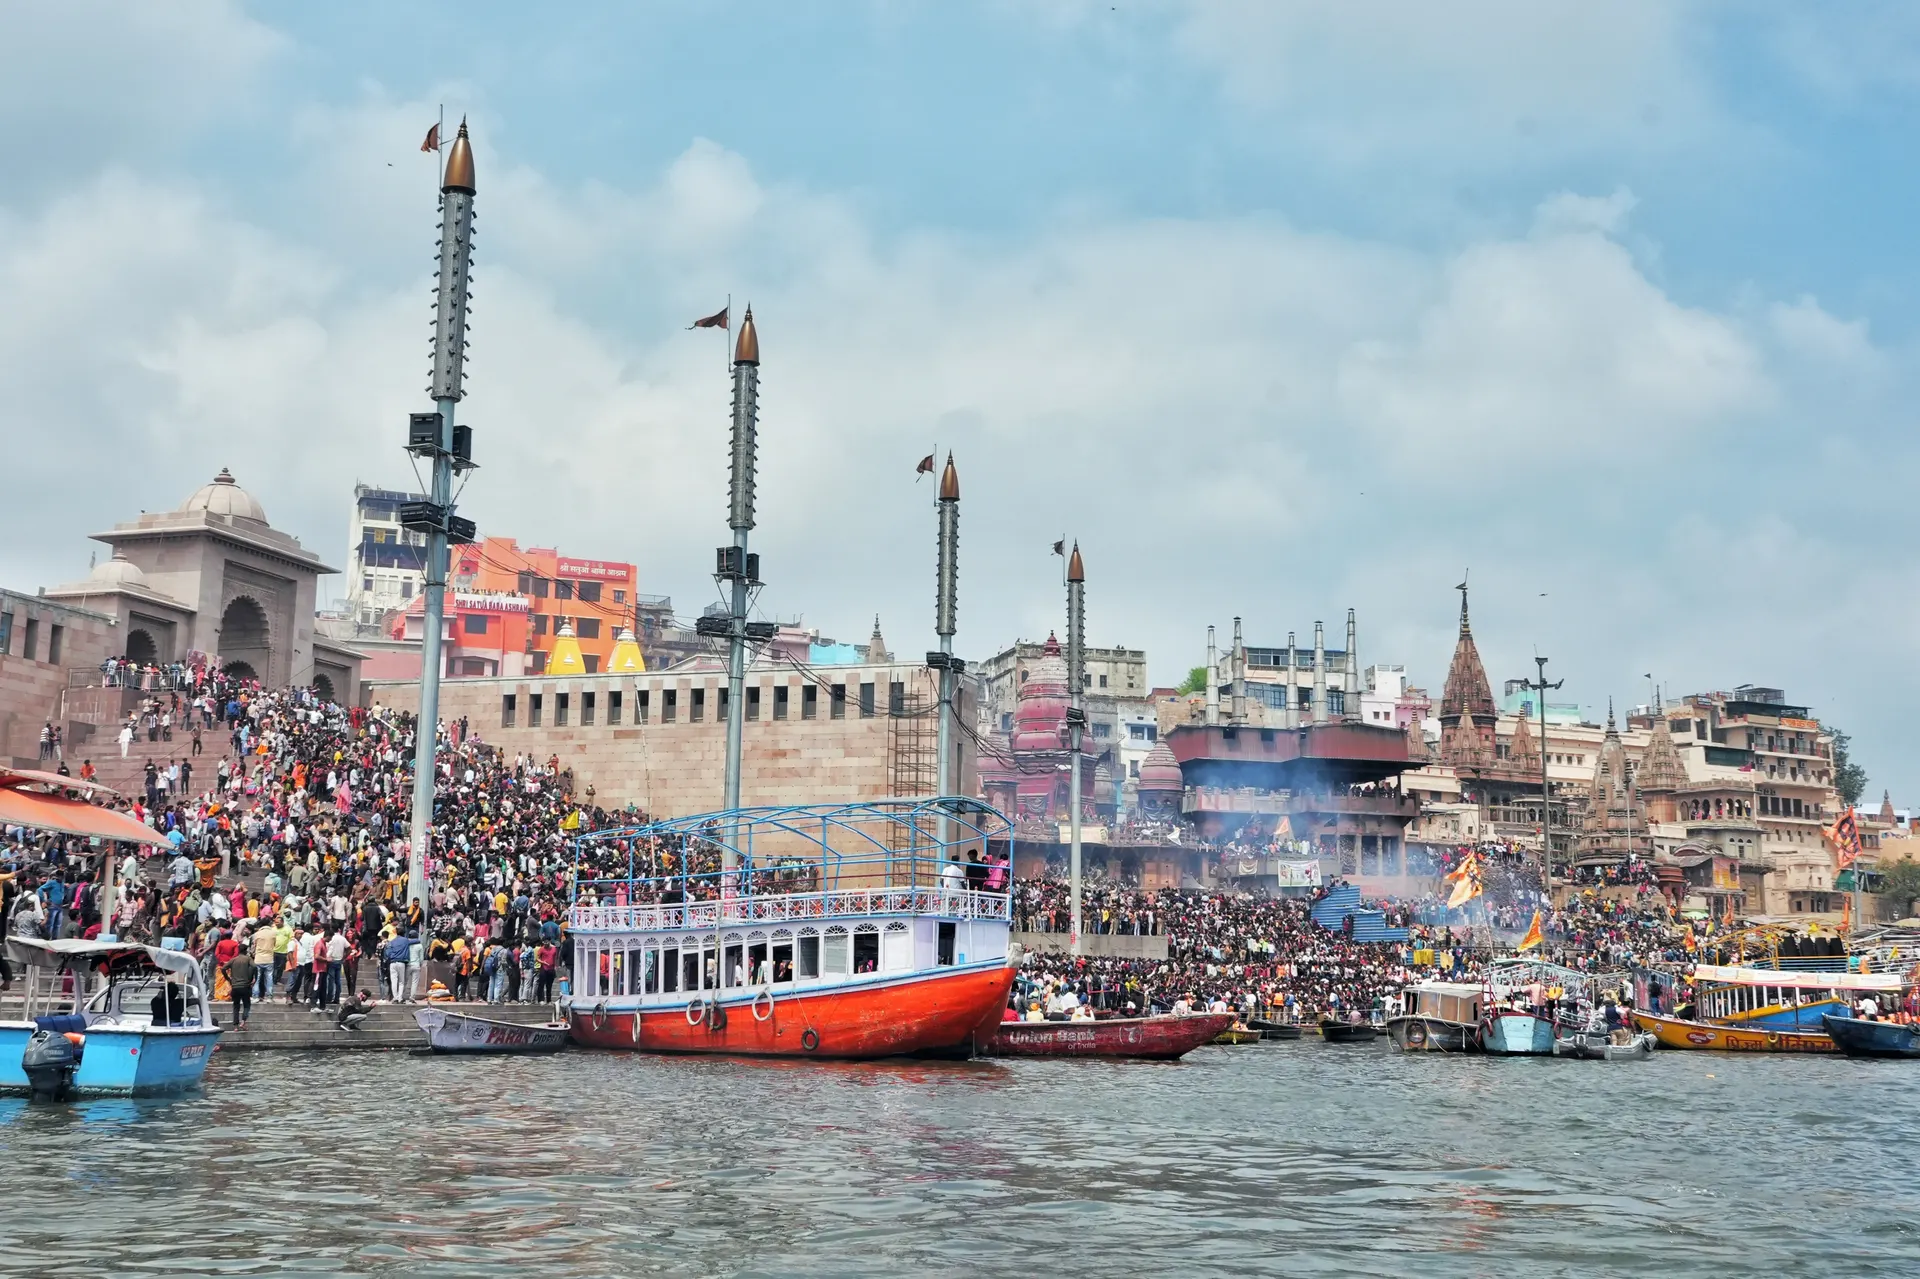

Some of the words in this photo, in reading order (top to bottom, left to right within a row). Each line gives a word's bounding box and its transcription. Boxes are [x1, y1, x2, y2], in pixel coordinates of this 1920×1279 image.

[560, 563, 569, 572] श्री
[591, 567, 606, 575] बाबा
[607, 569, 627, 577] आश्रम
[455, 599, 468, 608] SHRI
[469, 600, 488, 609] SATUA
[488, 601, 504, 610] BABA
[504, 603, 528, 612] ASHRAM
[473, 1027, 484, 1037] 50
[1010, 1030, 1053, 1044] Union
[1056, 1028, 1096, 1042] Bank
[1077, 1041, 1097, 1050] India
